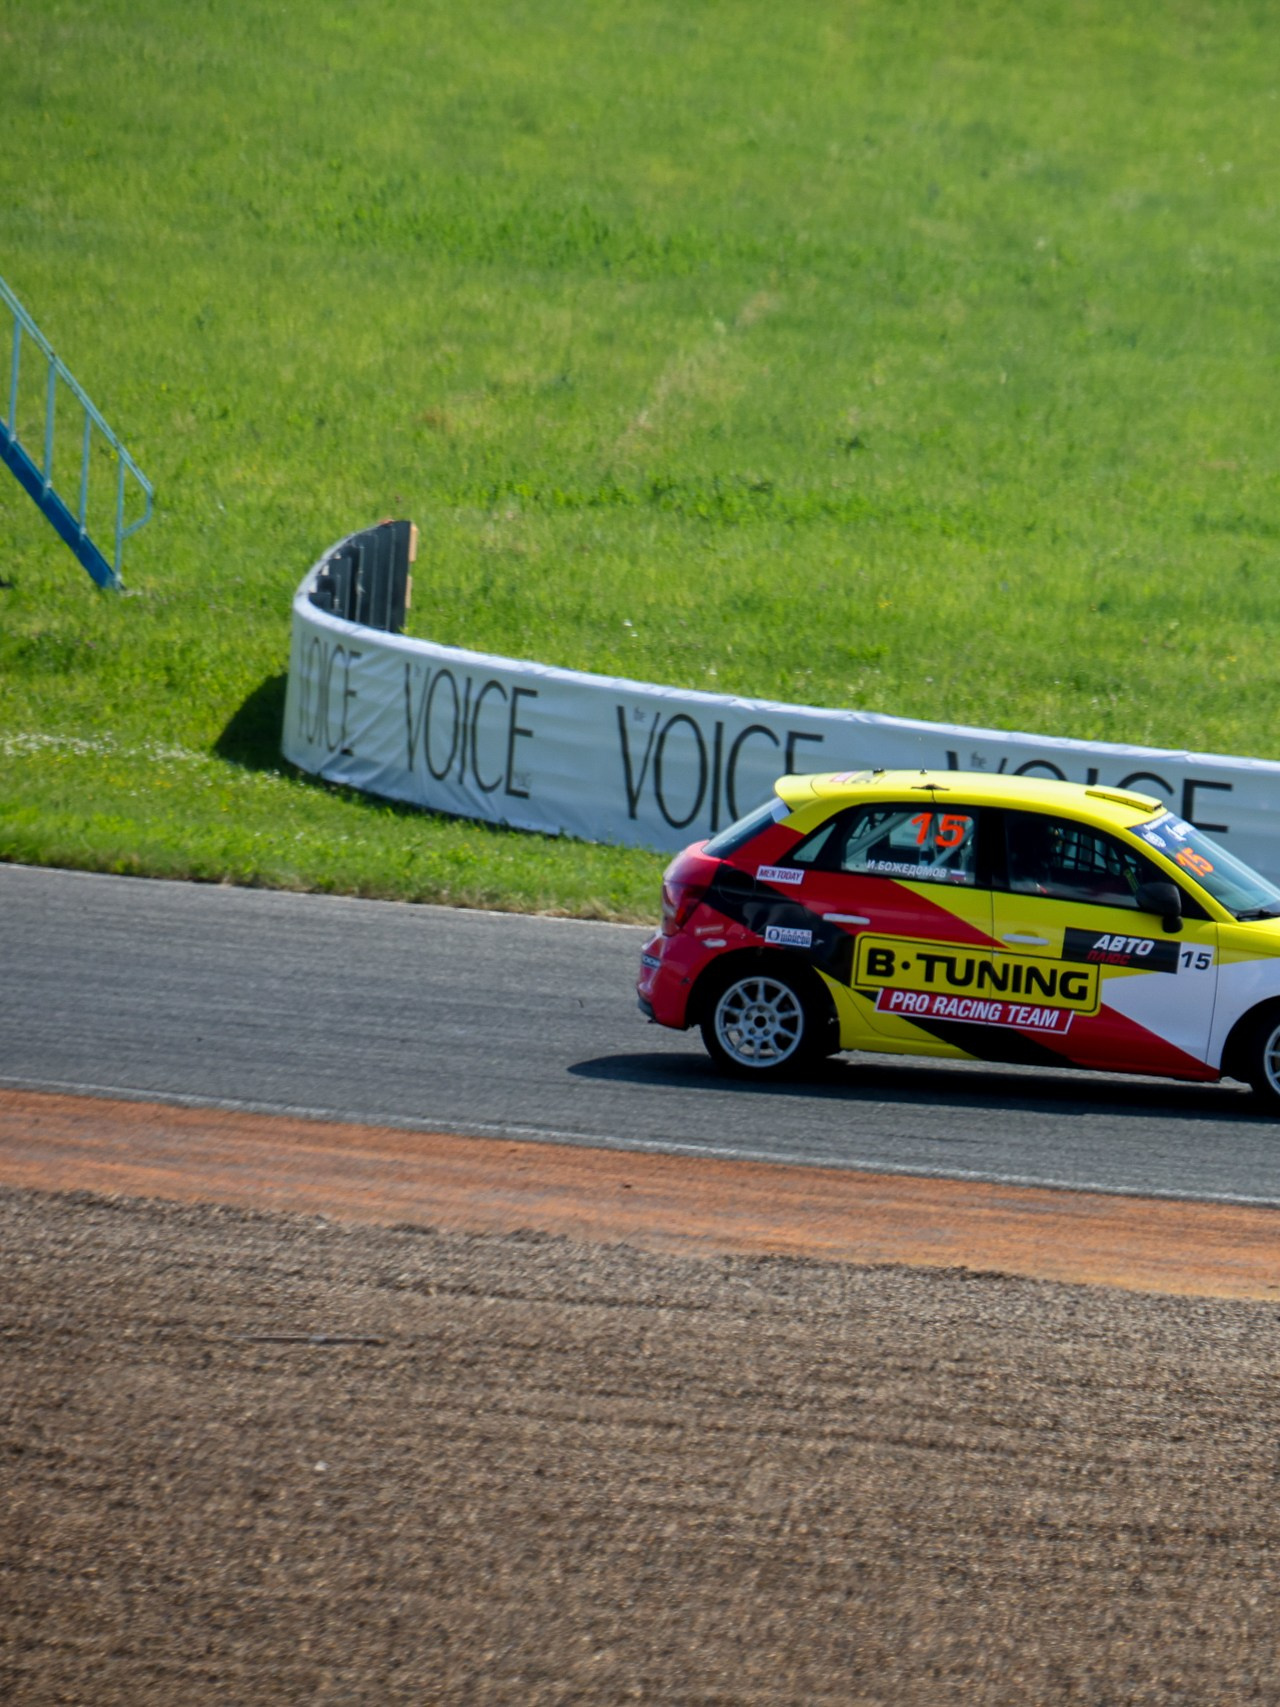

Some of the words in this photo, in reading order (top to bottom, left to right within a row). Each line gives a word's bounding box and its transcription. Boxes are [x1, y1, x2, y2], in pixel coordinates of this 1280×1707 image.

[405, 662, 538, 799] VOICE
[911, 812, 969, 847] 15
[777, 870, 803, 882] TODAY
[1092, 934, 1155, 956] АВТО
[1181, 950, 1212, 970] 15
[889, 991, 930, 1013] PRO
[931, 997, 1003, 1021] RACING
[1008, 1005, 1061, 1028] TEAM
